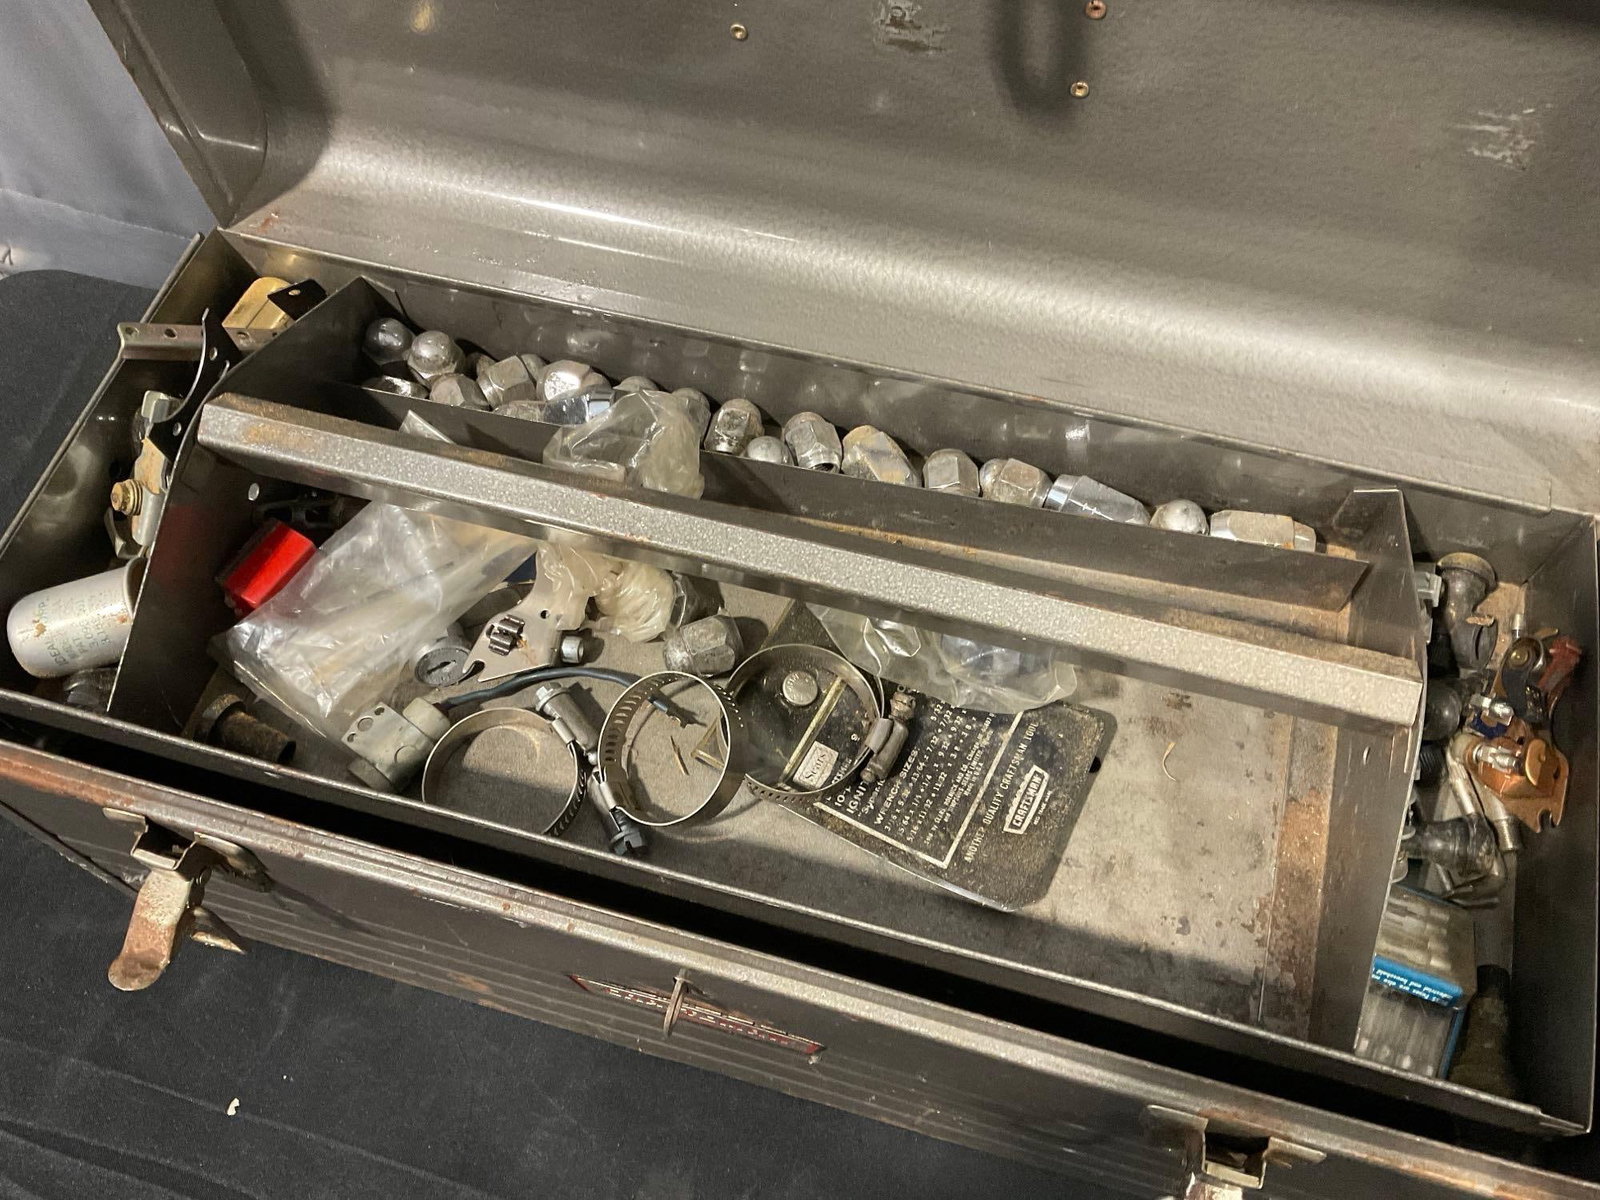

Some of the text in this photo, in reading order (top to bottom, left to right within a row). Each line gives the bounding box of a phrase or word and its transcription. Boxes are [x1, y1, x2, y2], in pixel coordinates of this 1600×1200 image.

[803, 750, 828, 782] Sears
[873, 778, 903, 826] WRENCH
[898, 745, 921, 779] SIZES:
[982, 790, 1004, 825] QUALITY
[1023, 720, 1038, 741] TOOL
[1012, 772, 1042, 827] CRAFTSMAN
